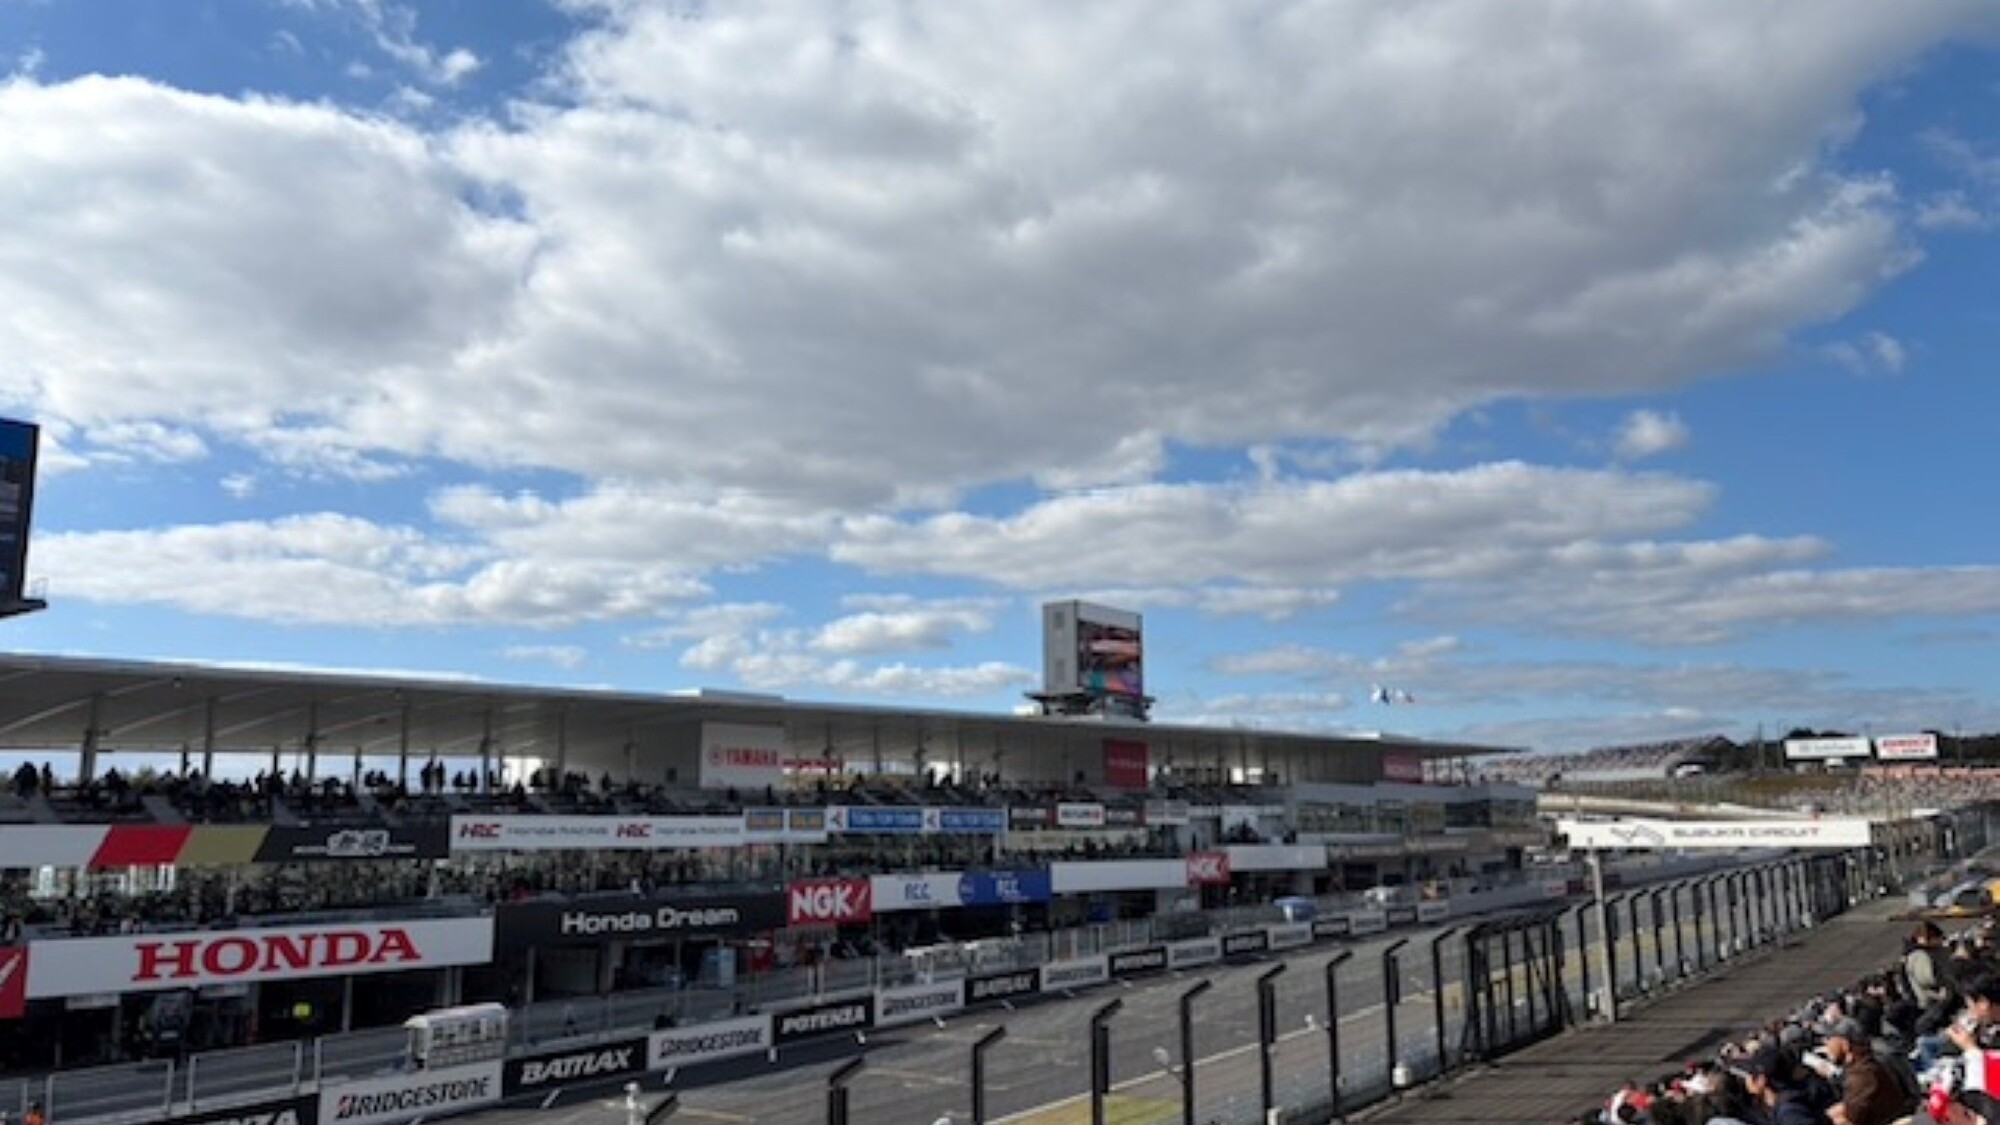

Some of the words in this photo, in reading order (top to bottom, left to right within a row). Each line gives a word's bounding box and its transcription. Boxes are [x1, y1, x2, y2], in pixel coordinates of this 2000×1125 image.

[459, 823, 503, 839] HRC
[616, 823, 653, 839] HRC
[791, 883, 853, 920] NGK
[561, 911, 651, 935] Honda
[657, 906, 738, 929] Dream
[131, 929, 421, 981] HONDA
[781, 1004, 866, 1034] POTENZA
[659, 1026, 763, 1060] BRIDGESTONE
[520, 1048, 634, 1085] BATTLAX
[336, 1077, 490, 1119] BRIDGESTONE
